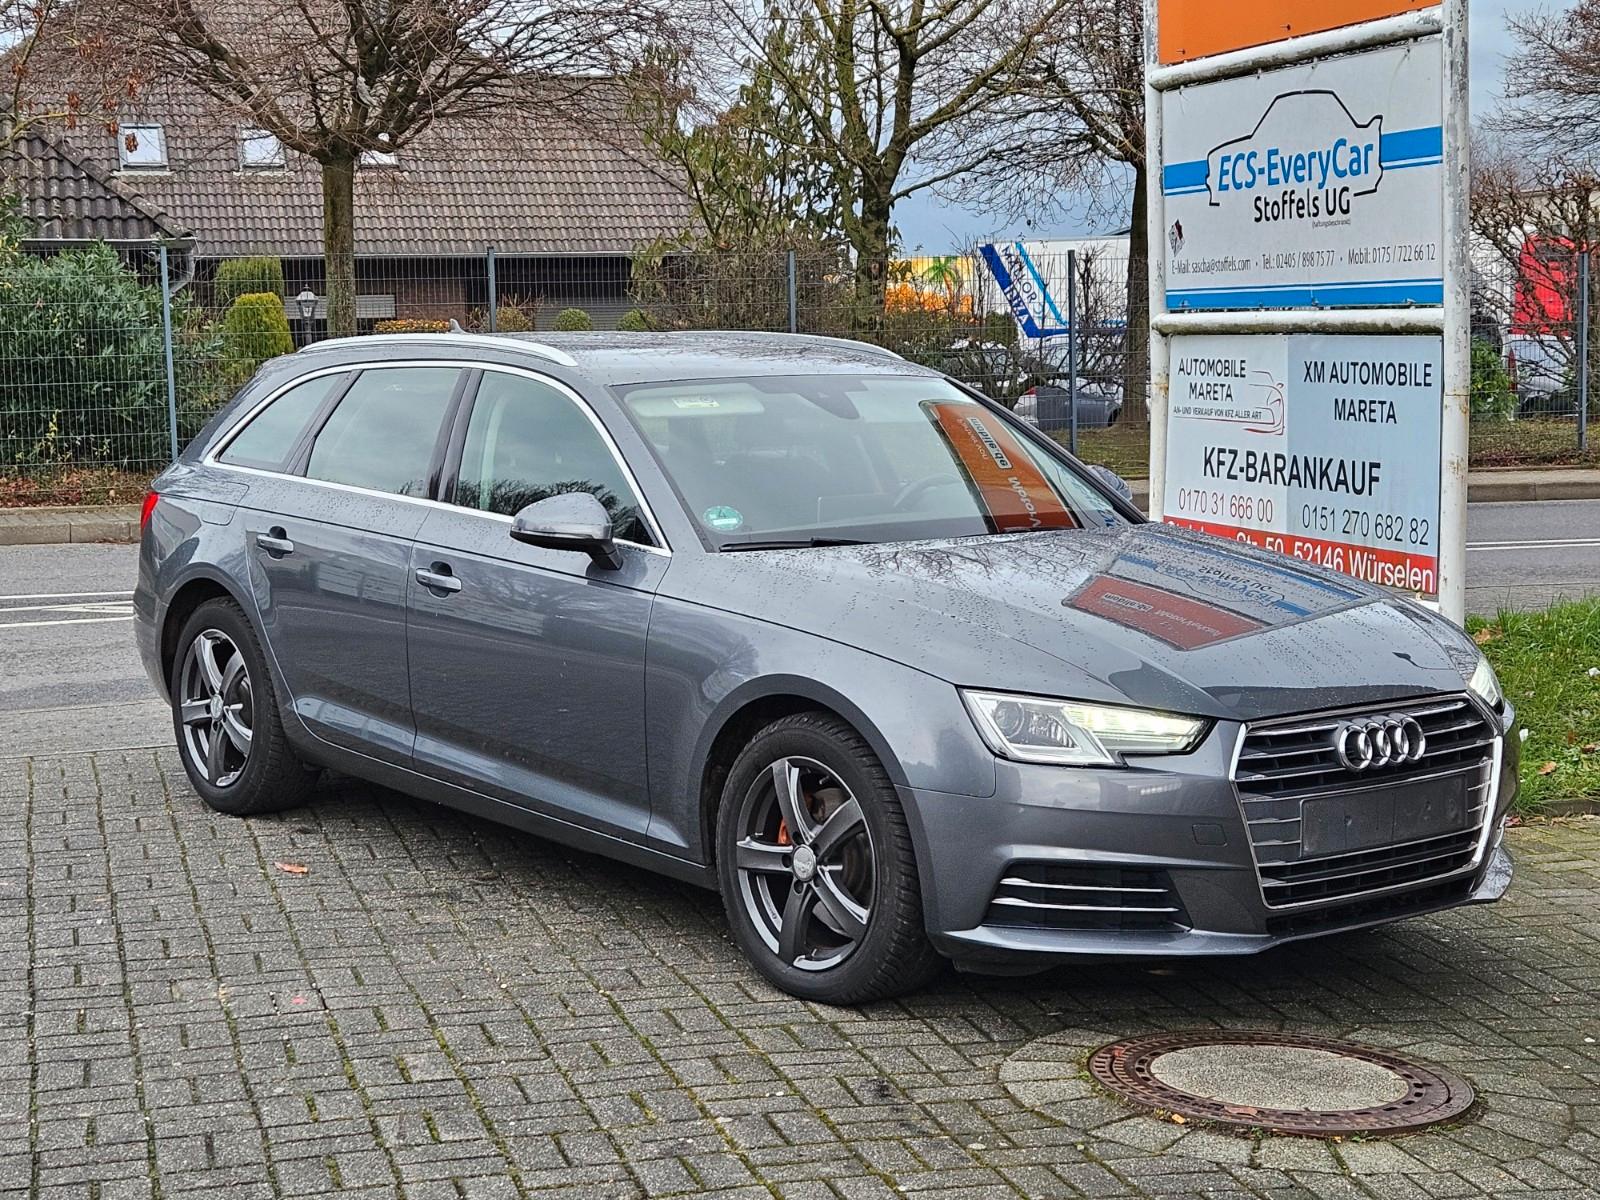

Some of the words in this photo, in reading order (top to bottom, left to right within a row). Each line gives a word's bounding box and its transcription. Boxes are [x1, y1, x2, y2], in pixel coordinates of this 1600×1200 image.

[1218, 138, 1374, 191] ECS-EveryCar
[1254, 188, 1320, 222] Stoffels
[1325, 186, 1350, 216] UG
[1171, 259, 1191, 275] E-Mail:
[1192, 256, 1251, 274] sascha@stoffels.com
[1262, 254, 1275, 270] Tel.:
[1276, 253, 1296, 269] 02405
[1348, 247, 1371, 265] Mobil:
[1372, 247, 1391, 263] 0175
[1398, 245, 1412, 262] 722
[1414, 244, 1424, 261] 66
[1427, 243, 1436, 261] 12
[1178, 358, 1246, 378] AUTOMOBILE
[1304, 361, 1325, 383] XM
[1329, 361, 1432, 387] AUTOMOBILE
[1189, 382, 1233, 402] MARETA
[1182, 407, 1192, 415] UND
[1193, 407, 1213, 416] VERKAUF
[1214, 408, 1224, 417] VON
[1225, 409, 1234, 418] KFZ
[1235, 410, 1250, 419] ALLER
[1251, 411, 1262, 420] ART
[1334, 398, 1397, 424] MARETA
[1203, 446, 1381, 497] KFZ-BARANKAUF
[1178, 487, 1207, 514] 0170
[1211, 492, 1225, 516] 31
[1229, 495, 1253, 521] 666
[1257, 498, 1273, 523] 00
[1302, 504, 1335, 532] 0151
[1342, 509, 1370, 537] 270
[1374, 513, 1404, 543] 682
[1409, 517, 1430, 546] 82
[1349, 549, 1433, 593] Würselen
